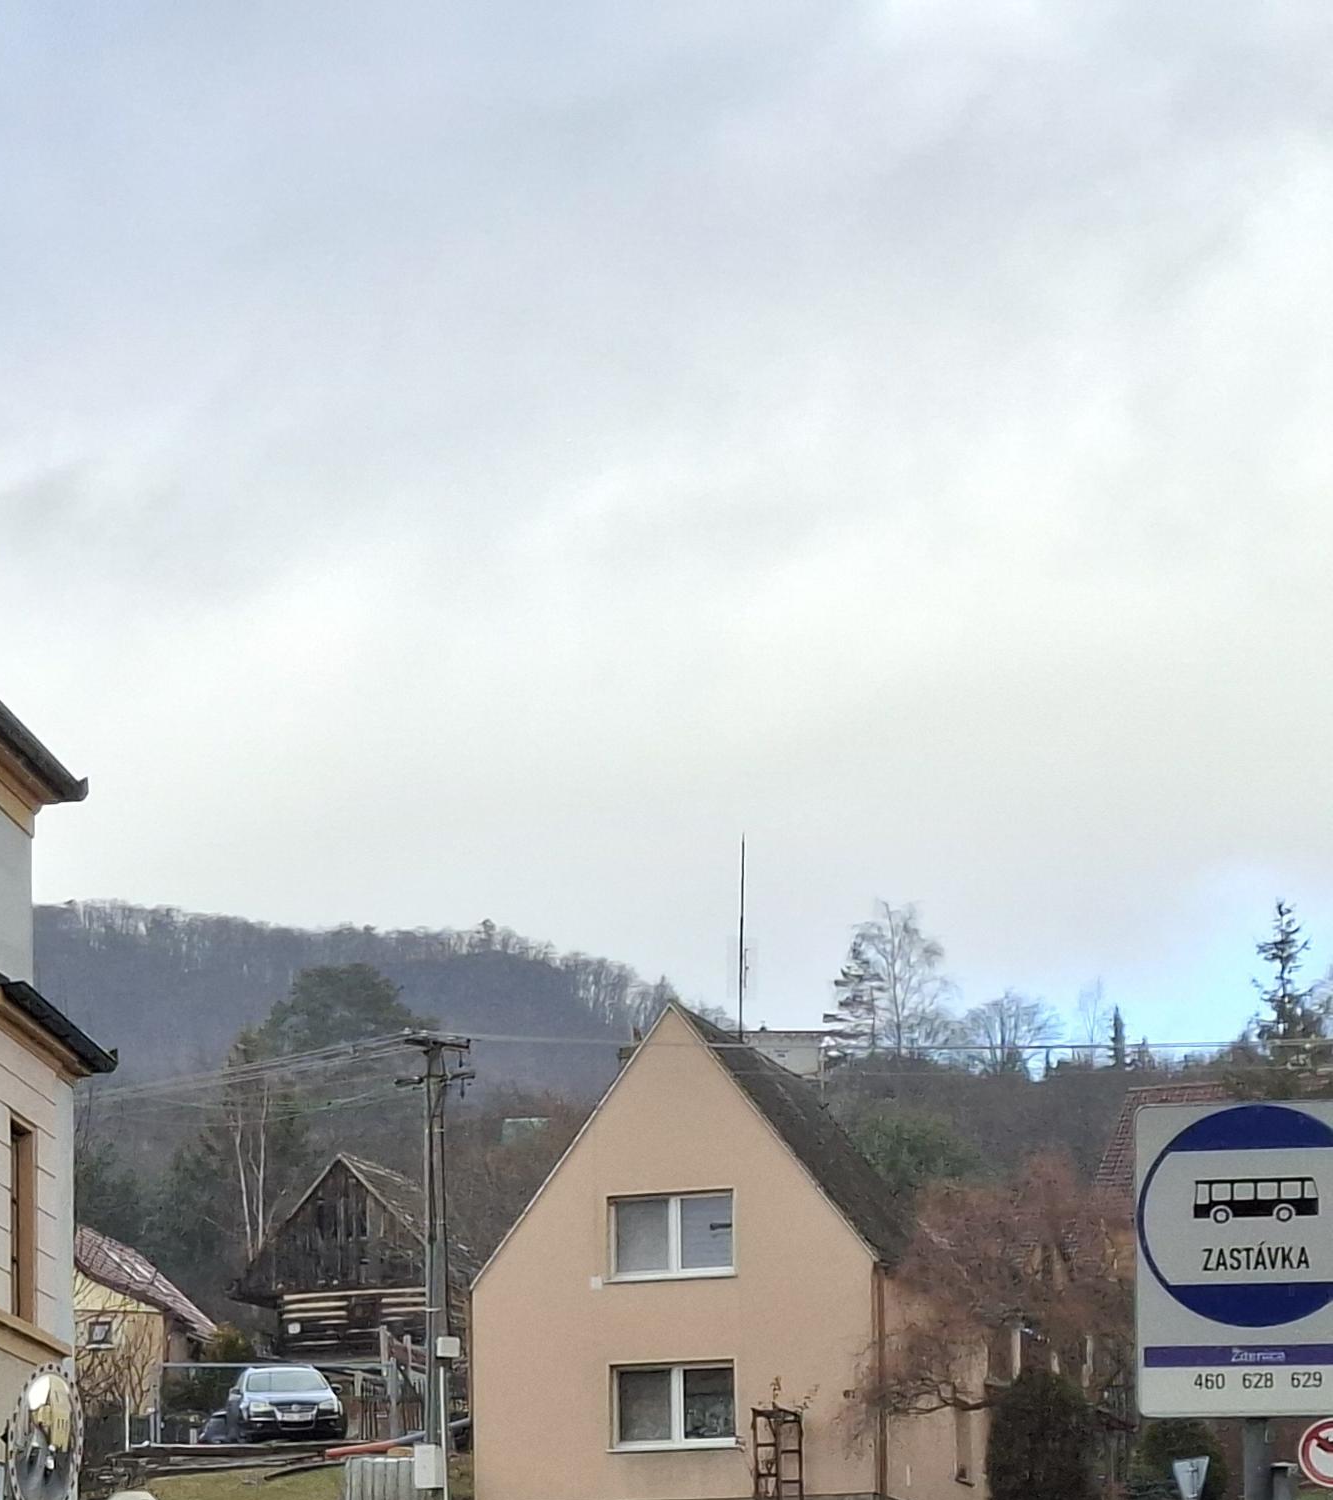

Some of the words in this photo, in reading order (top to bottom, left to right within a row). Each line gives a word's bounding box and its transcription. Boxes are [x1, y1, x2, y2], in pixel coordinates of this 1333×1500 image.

[1202, 1241, 1310, 1271] ZASTÁVKA
[1194, 1373, 1225, 1390] 460
[1242, 1372, 1274, 1389] 628
[1291, 1371, 1322, 1389] 629
